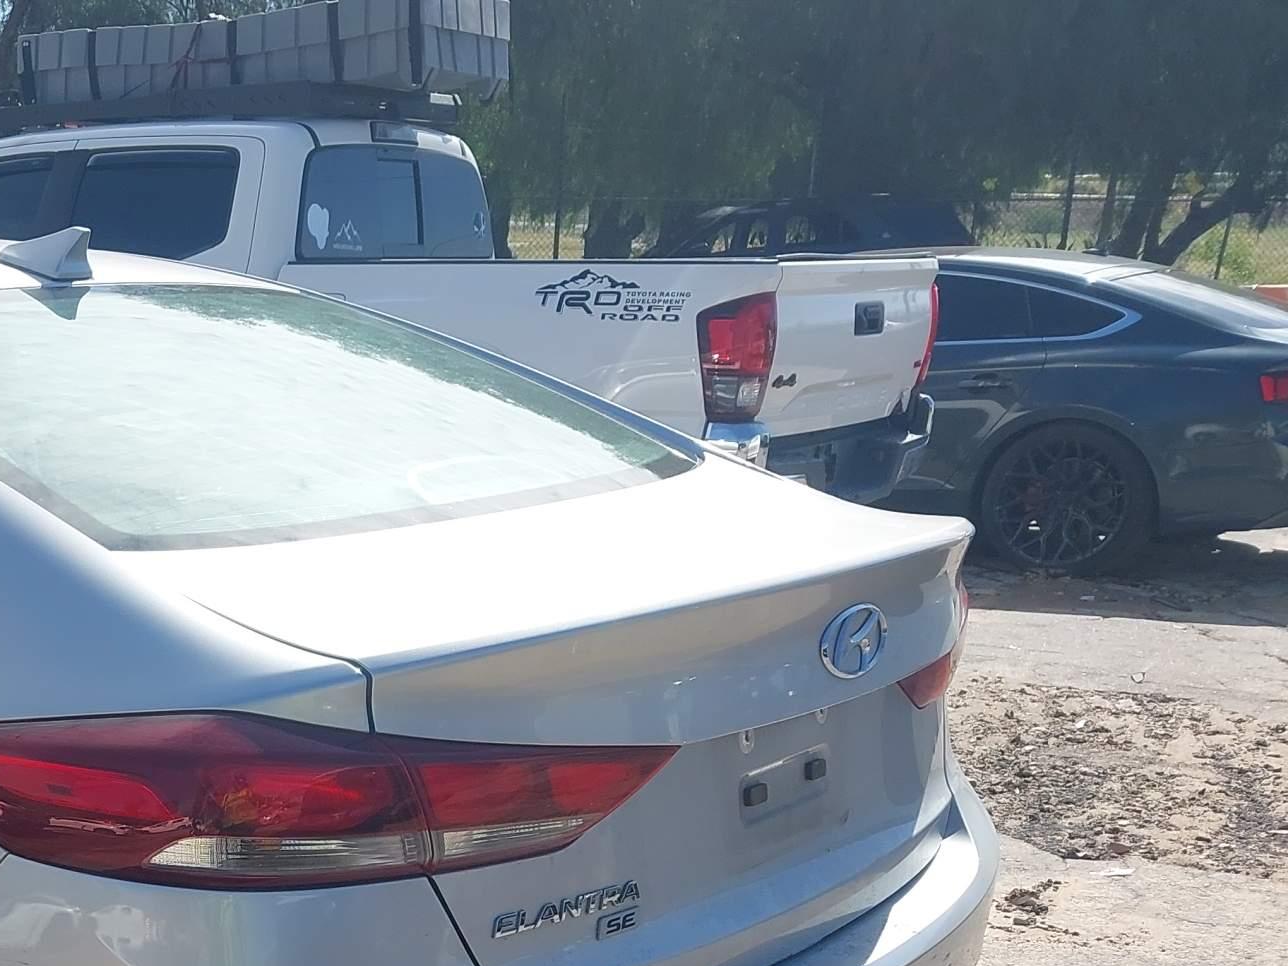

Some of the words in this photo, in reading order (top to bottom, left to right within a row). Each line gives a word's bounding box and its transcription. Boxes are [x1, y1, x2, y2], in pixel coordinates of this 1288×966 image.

[535, 290, 621, 314] TRD
[625, 297, 687, 305] DEVELOPMENT
[601, 313, 680, 321] ROAD
[491, 880, 641, 939] ELANTRA
[606, 912, 636, 935] SE
